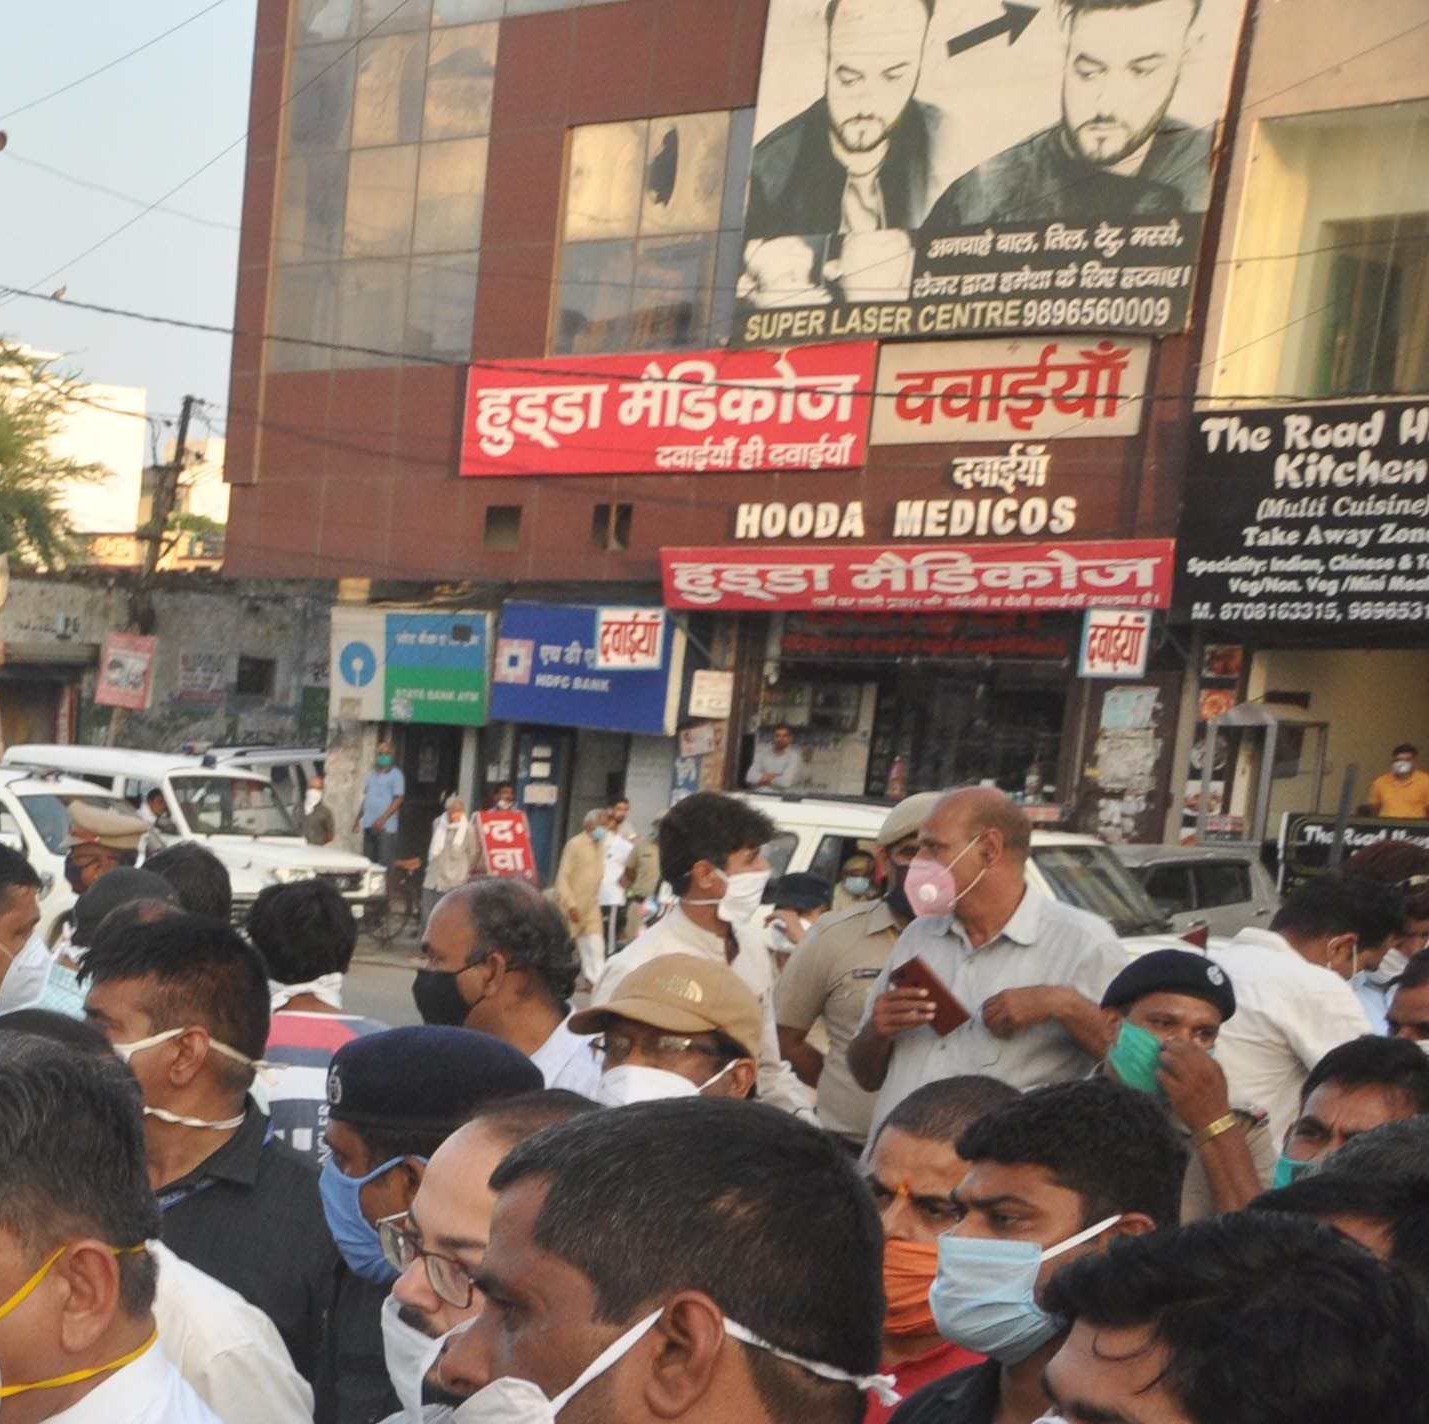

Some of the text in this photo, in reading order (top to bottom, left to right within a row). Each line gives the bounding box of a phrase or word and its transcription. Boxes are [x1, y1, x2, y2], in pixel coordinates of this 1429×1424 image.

[998, 264, 1055, 294] हमेशा
[1054, 261, 1079, 288] के
[745, 296, 1171, 343] SUPER LASER CENTRE 9896560009
[894, 341, 1135, 433] दवाईयाँ
[1200, 415, 1272, 453] The
[1283, 409, 1386, 450] Road
[1274, 450, 1429, 489] Kitchen
[734, 495, 1078, 540] HOODA MEDICOS
[1256, 496, 1327, 522] (Multi
[1241, 526, 1301, 547] Take
[1303, 524, 1373, 549] Away
[1269, 554, 1325, 574] Indian,
[1328, 552, 1395, 571] Chinese
[534, 674, 613, 692] HDFC BANK
[1303, 825, 1335, 845] The
